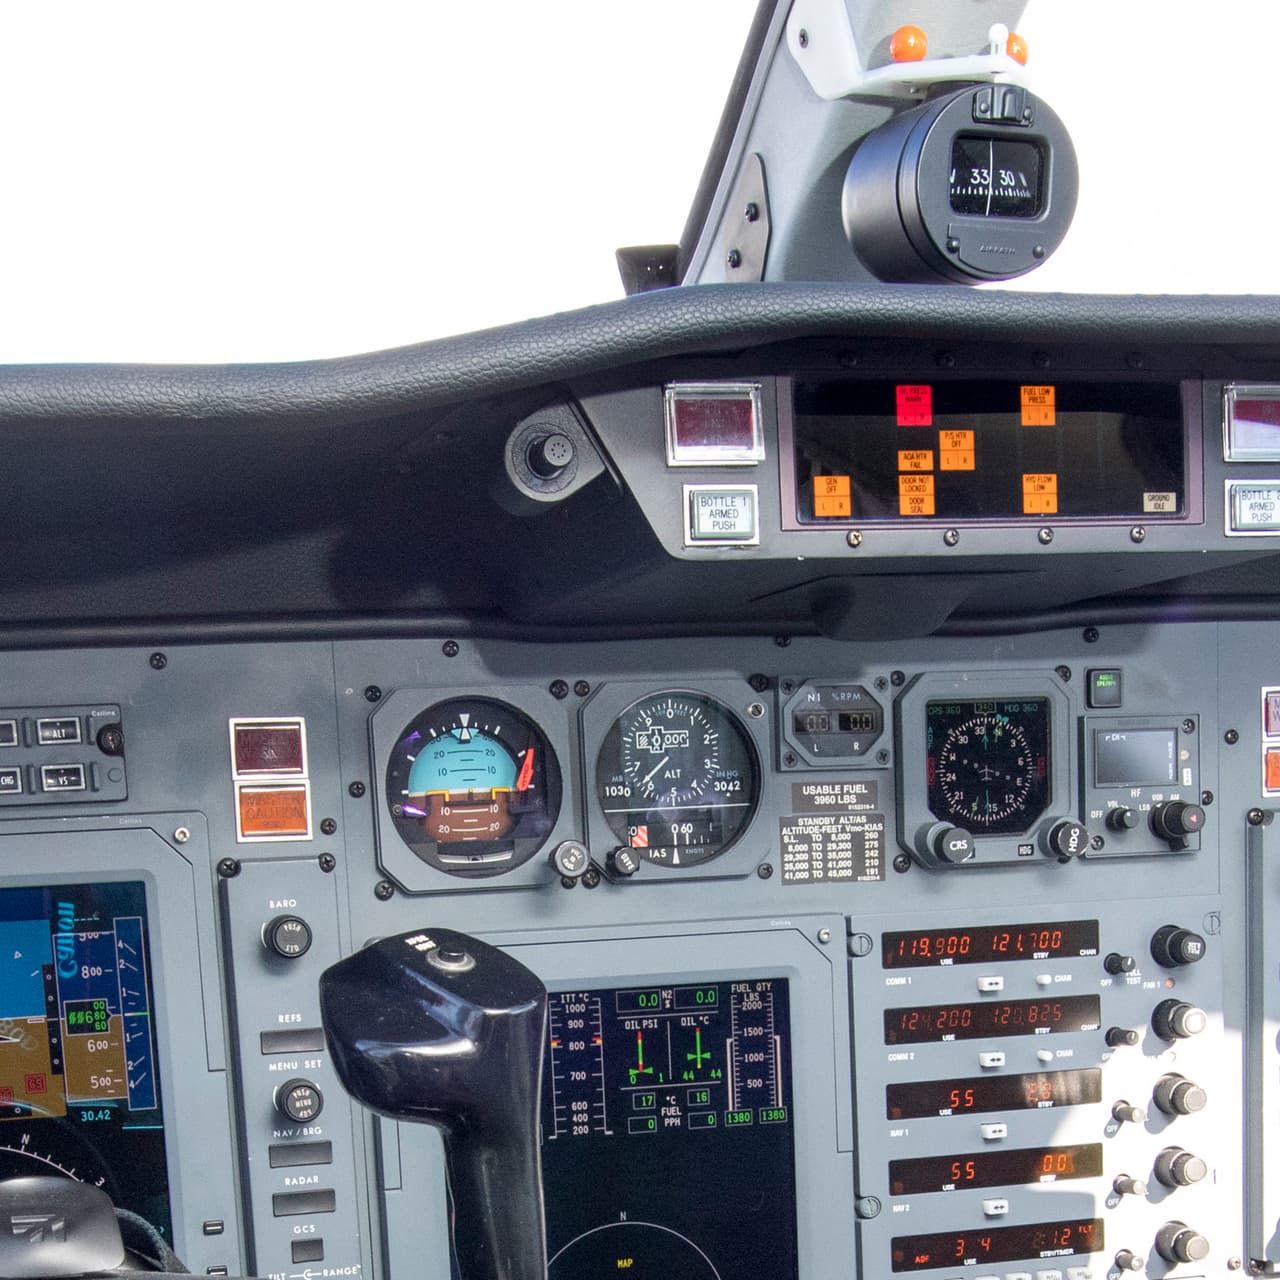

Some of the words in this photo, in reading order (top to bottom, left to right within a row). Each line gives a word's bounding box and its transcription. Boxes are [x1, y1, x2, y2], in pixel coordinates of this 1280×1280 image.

[970, 168, 989, 184] 33
[1000, 169, 1015, 186] 30
[1241, 489, 1272, 501] BOTTLE
[699, 496, 736, 508] BOTTLE
[742, 496, 748, 507] 1
[1249, 501, 1280, 512] ARMED
[708, 509, 741, 519] ARMED
[1251, 512, 1278, 522] PUSH
[712, 519, 738, 530] PUSH
[53, 729, 66, 738] ALT
[664, 769, 681, 778] ALT
[605, 786, 630, 797] 1030
[714, 781, 741, 792] 3042
[803, 785, 841, 795] USABLE
[844, 785, 868, 794] FUEL
[798, 817, 833, 825] STANDBY
[836, 815, 866, 824] ALT/AS
[950, 840, 967, 850] CRS
[1068, 828, 1080, 852] HDG
[649, 849, 667, 858] IAS
[269, 899, 297, 908] BARO
[899, 936, 970, 957] 119.900
[731, 983, 752, 993] FUEL
[756, 983, 771, 992] QTY
[278, 1014, 302, 1023] REFS
[87, 1040, 108, 1051] 600
[269, 1061, 298, 1071] MENU
[304, 1059, 322, 1069] SET
[90, 1076, 111, 1087] 500
[81, 1110, 111, 1121] 30.42
[727, 1111, 751, 1123] 1380
[762, 1109, 785, 1121] 1380
[284, 1175, 318, 1185] RADAR
[618, 1258, 633, 1268] MAP
[323, 1266, 358, 1277] RANGE
